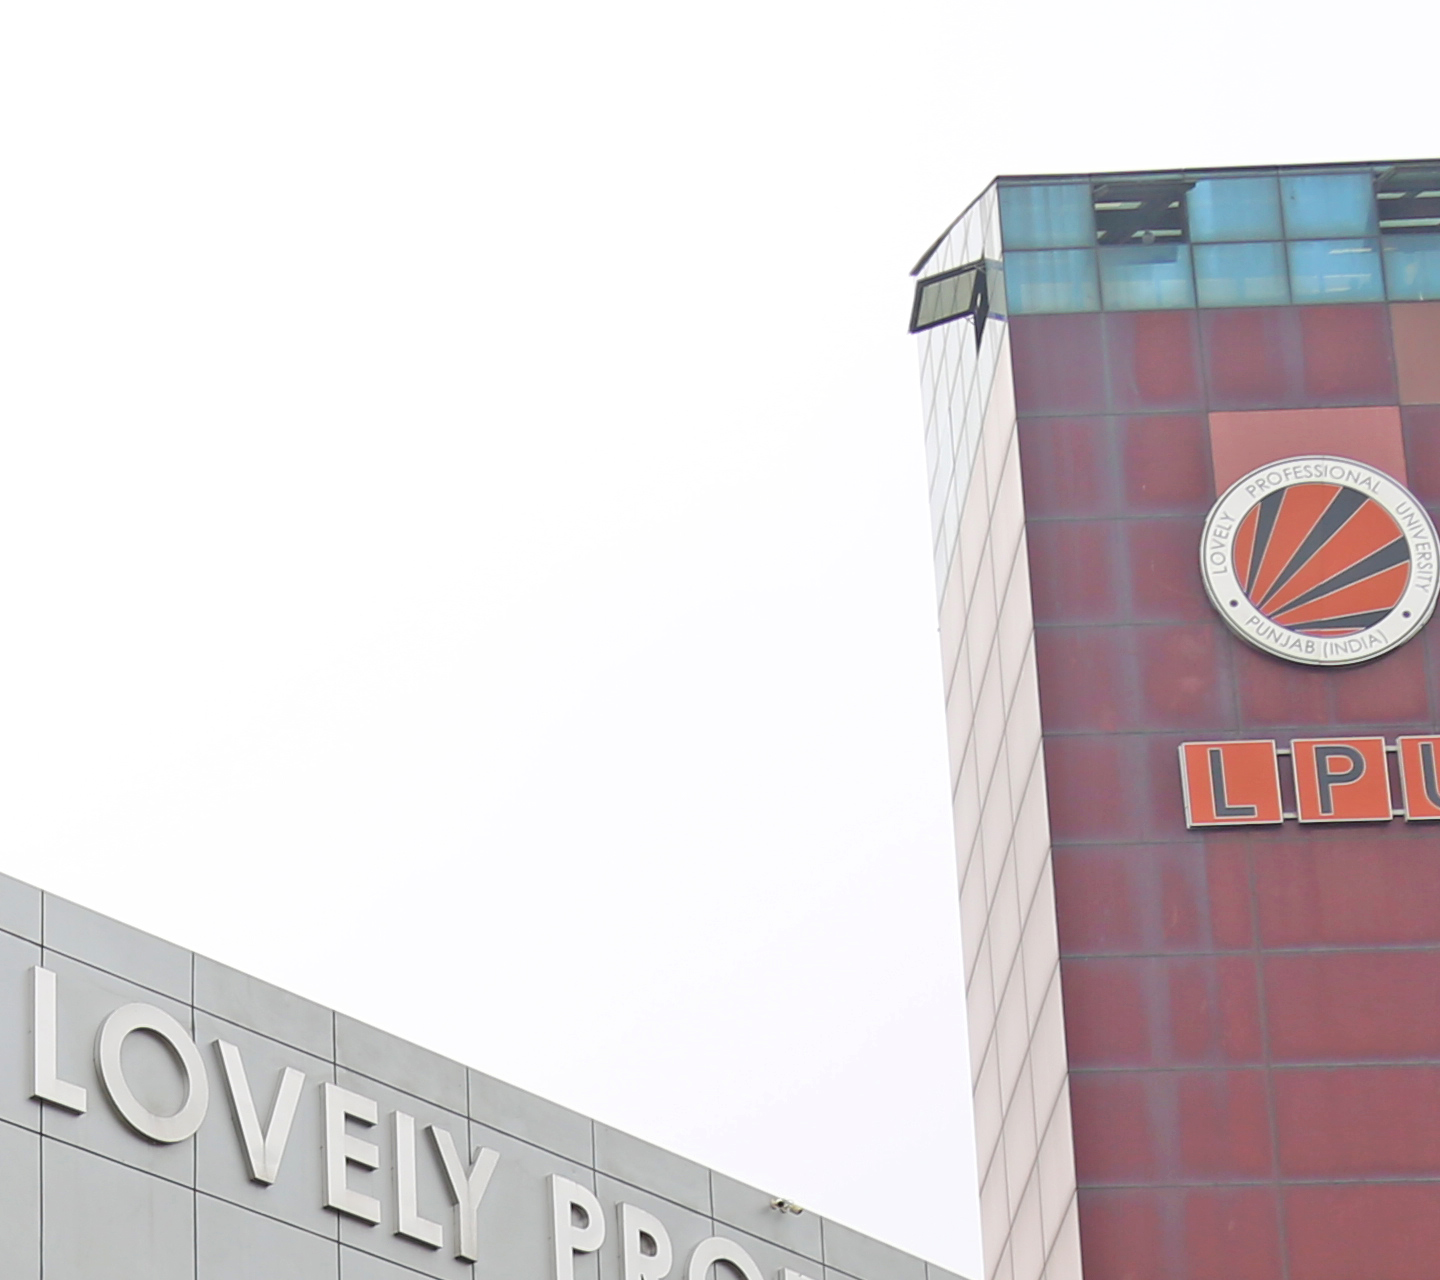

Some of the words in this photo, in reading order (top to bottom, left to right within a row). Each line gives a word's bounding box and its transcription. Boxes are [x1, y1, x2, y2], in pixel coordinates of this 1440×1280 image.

[1210, 511, 1237, 575] LOVELY
[1245, 464, 1381, 499] PROFESSIONAL
[1395, 501, 1433, 593] UNIVERSITY
[1245, 616, 1315, 655] PUNJAB
[1323, 628, 1389, 658] (INDIA)
[28, 965, 500, 1263] LOVELY
